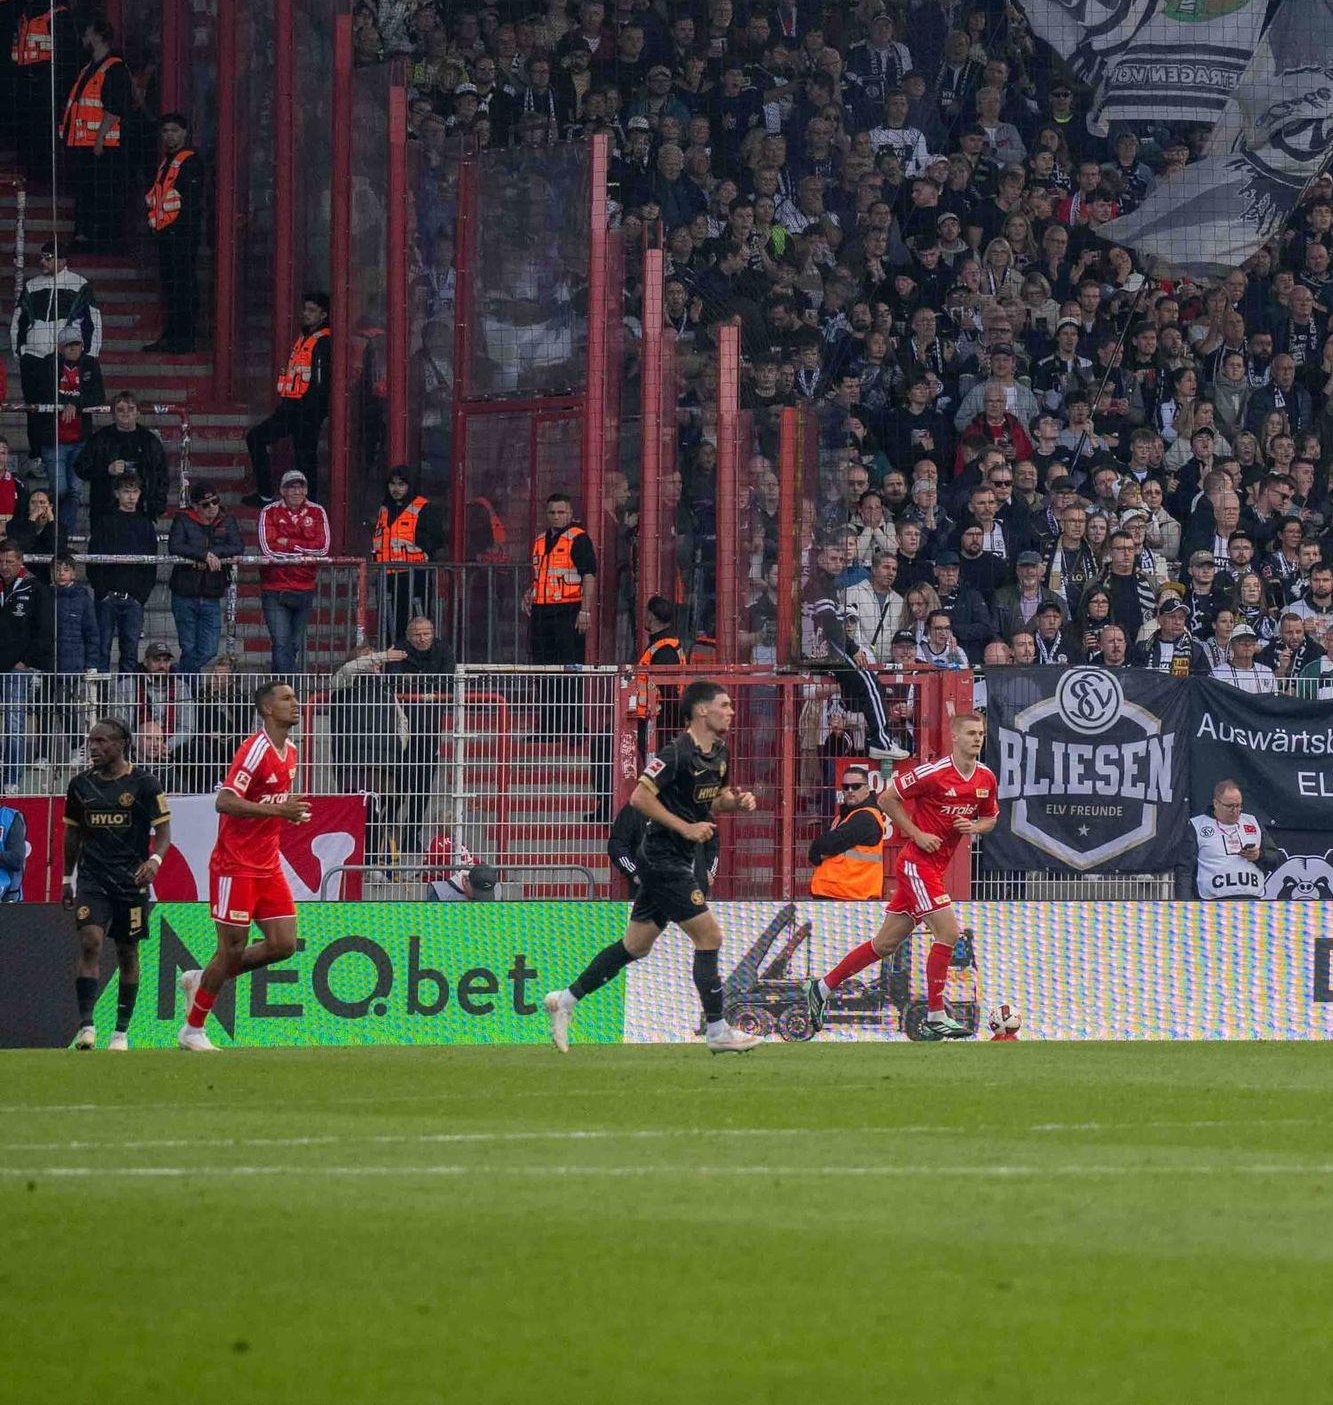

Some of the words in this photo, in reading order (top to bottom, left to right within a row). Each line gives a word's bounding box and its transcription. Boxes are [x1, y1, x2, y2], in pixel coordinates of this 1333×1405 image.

[999, 727, 1175, 803] BLIESEN
[1046, 803, 1069, 816] ELV
[1072, 803, 1124, 817] FREUNDE
[1212, 872, 1259, 888] CLUB
